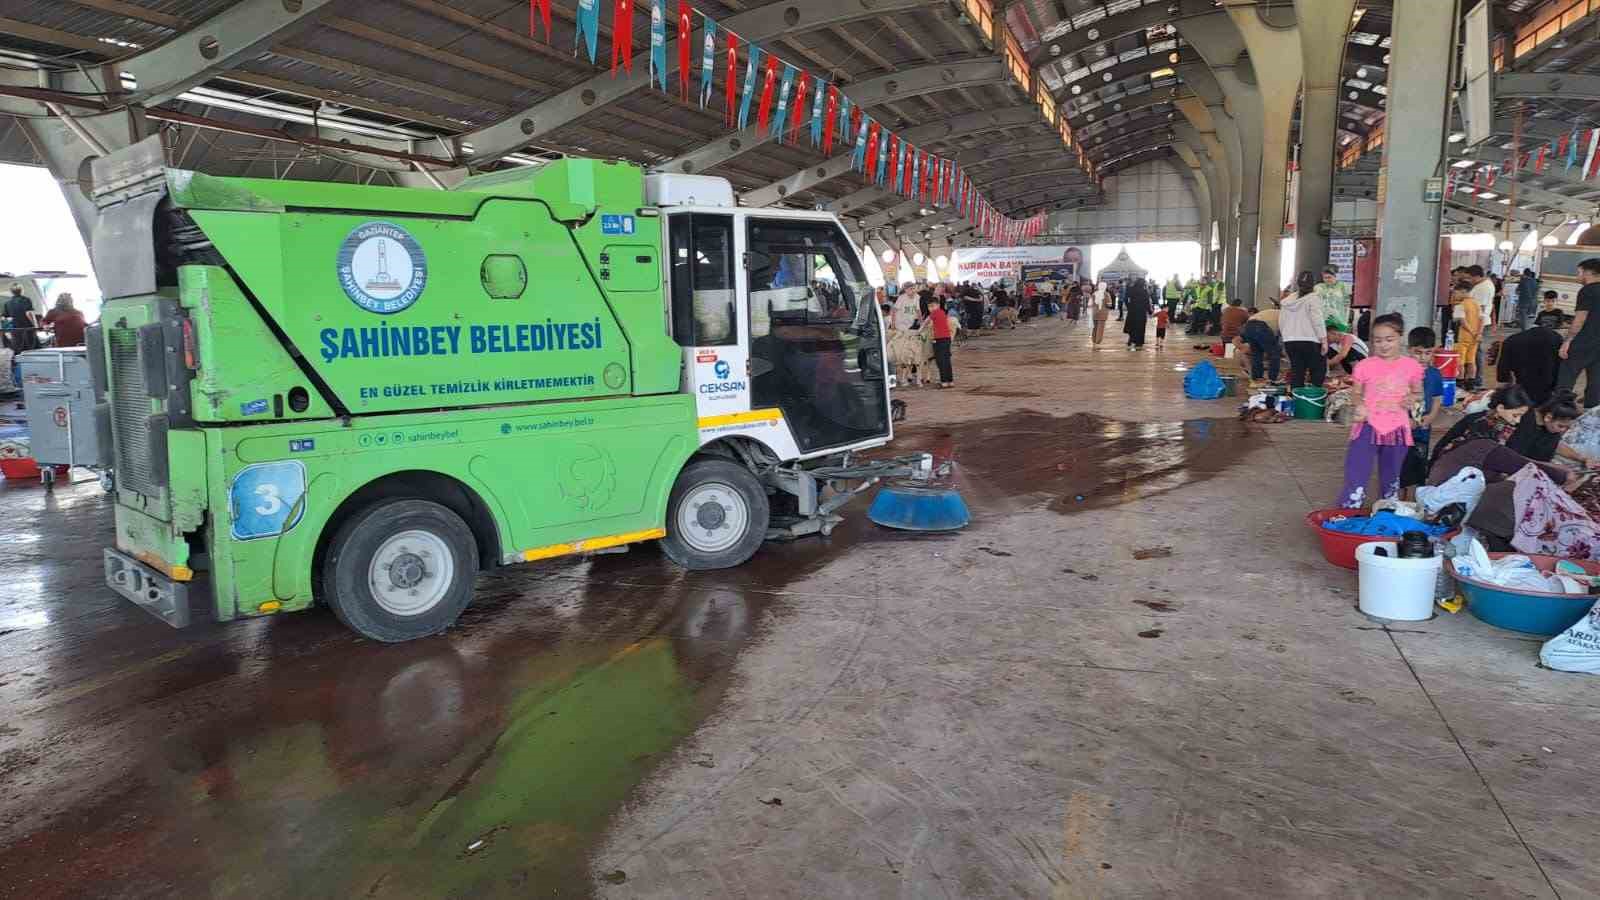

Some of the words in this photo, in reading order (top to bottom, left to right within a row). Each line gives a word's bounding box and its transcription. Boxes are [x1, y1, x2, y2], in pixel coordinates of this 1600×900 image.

[320, 321, 461, 363] ŞAHİNBEY
[470, 317, 602, 353] BELEDİYESİ
[360, 387, 378, 398] EN
[383, 384, 426, 397] GÜZEL
[431, 379, 490, 395] TEMİZLİK
[494, 375, 595, 391] KİRLETMEMEKTİR
[255, 483, 281, 516] 3
